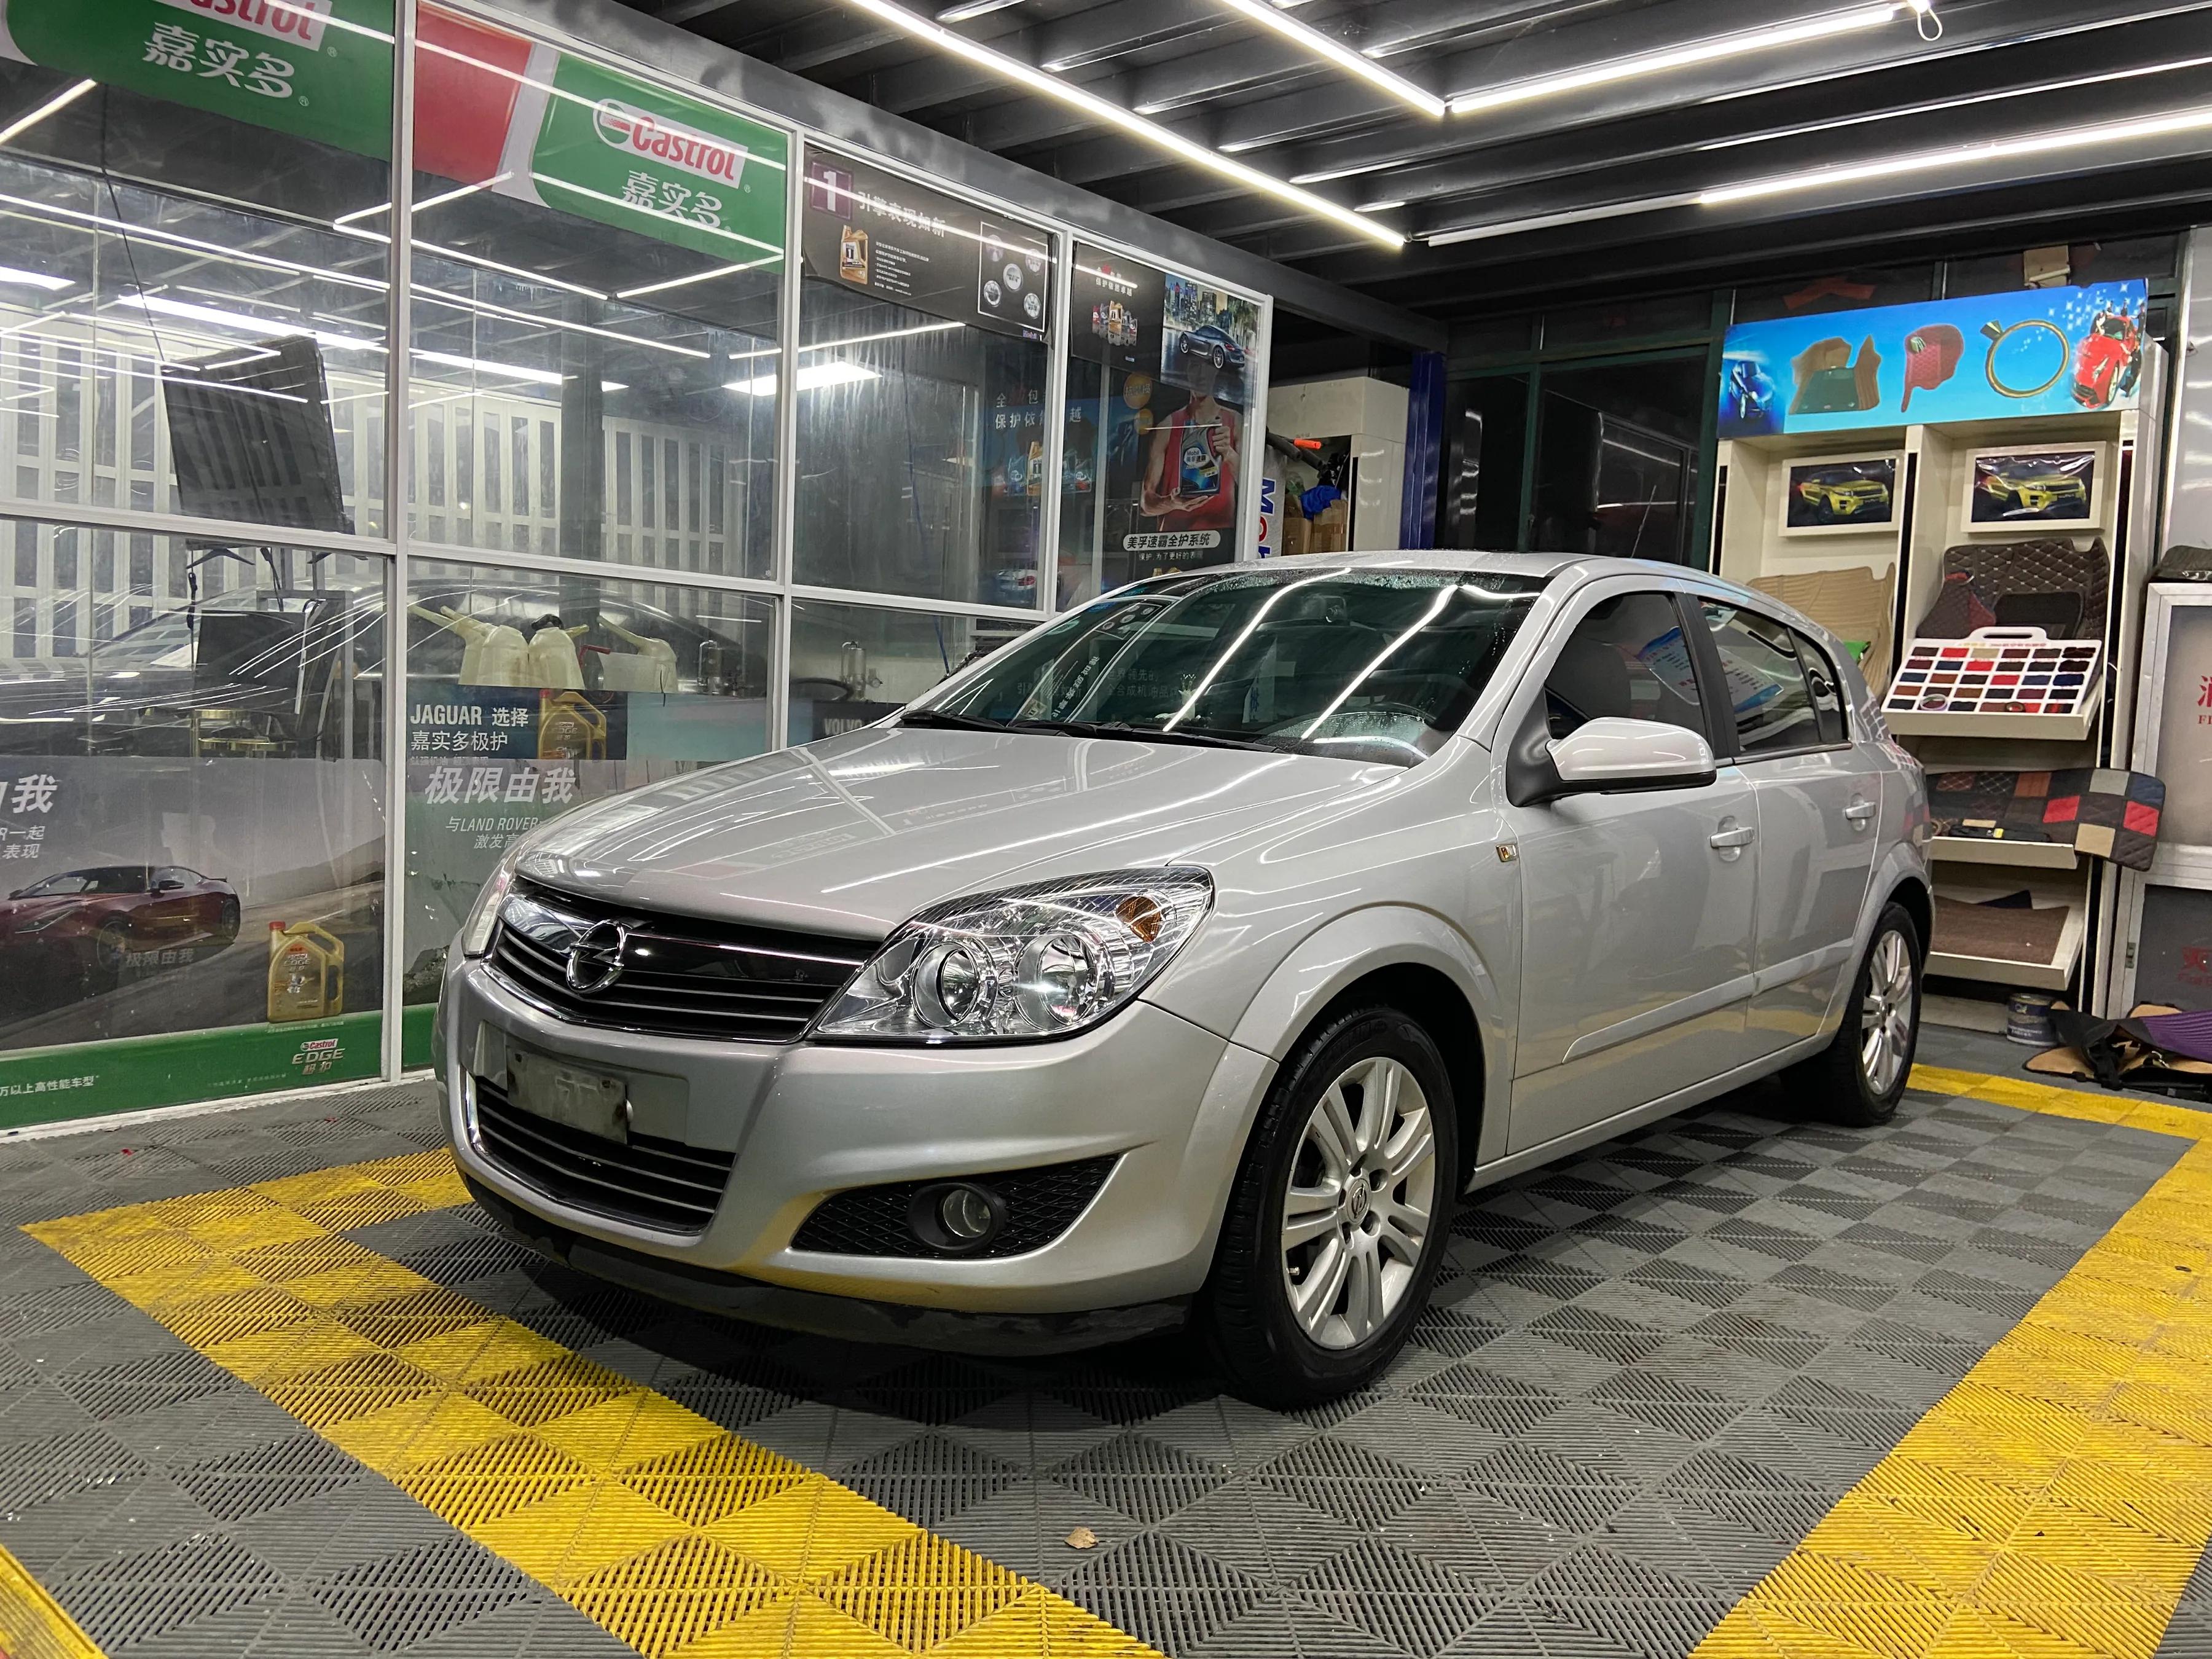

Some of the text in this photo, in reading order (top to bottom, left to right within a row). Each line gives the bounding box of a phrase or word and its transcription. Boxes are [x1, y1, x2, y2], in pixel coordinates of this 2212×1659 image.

[189, 0, 318, 41] strol
[142, 22, 294, 98] 嘉实多
[632, 116, 734, 181] Castrol
[621, 170, 722, 229] 嘉实多
[1069, 406, 1082, 423] 越
[1127, 533, 1210, 549] 美孚速霸全护系统
[410, 704, 529, 727] JAGUAR 选择
[411, 730, 508, 751] 嘉实多极护
[0, 774, 58, 814] 我
[425, 766, 576, 804] 极限由我
[445, 816, 539, 831] 与LAND ROVER
[2, 844, 41, 859] 表现
[310, 1040, 336, 1049] Castrol
[292, 1048, 346, 1065] EDGE
